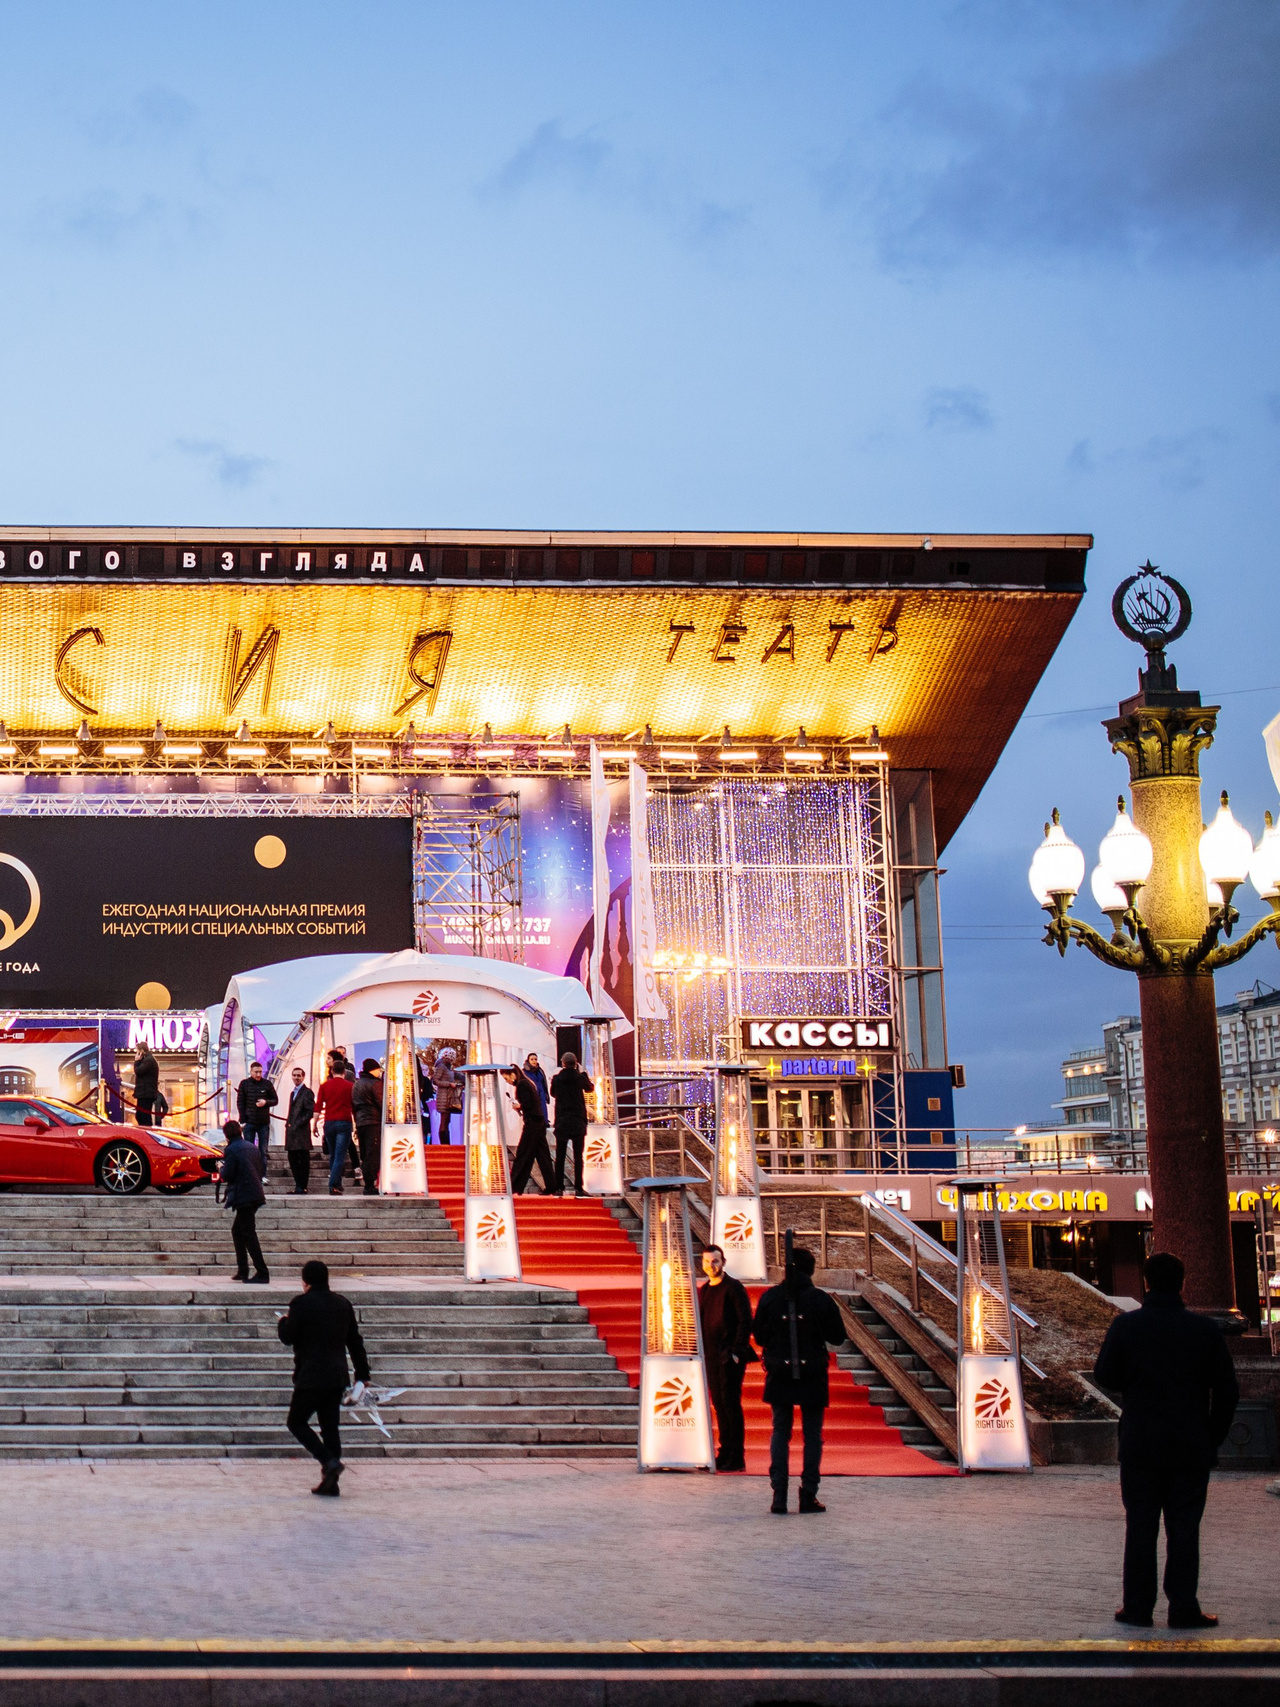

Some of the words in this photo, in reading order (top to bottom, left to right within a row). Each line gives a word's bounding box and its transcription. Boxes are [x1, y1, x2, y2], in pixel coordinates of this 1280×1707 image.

[182, 551, 425, 573] ВЗГЛЯДА
[666, 623, 899, 663] ТЕАТР
[102, 904, 186, 919] ЕЖЕГОДНАЯ
[189, 904, 307, 919] НАЦИОНАЛЬНАЯ
[310, 904, 366, 917] ПРЕМИЯ
[102, 923, 189, 937] ИНДУСТРИИ
[191, 923, 294, 937] СПЕЦИАЛЬНЫХ
[296, 922, 367, 935] СОБЫТИЙ
[6, 962, 41, 974] ГОДА
[749, 1022, 890, 1047] кассы
[781, 1058, 856, 1077] parter.ru
[654, 1418, 674, 1427] RIGHT
[676, 1418, 696, 1427] GUYS
[975, 1420, 994, 1429] RIGHT
[996, 1420, 1015, 1428] GUYS
